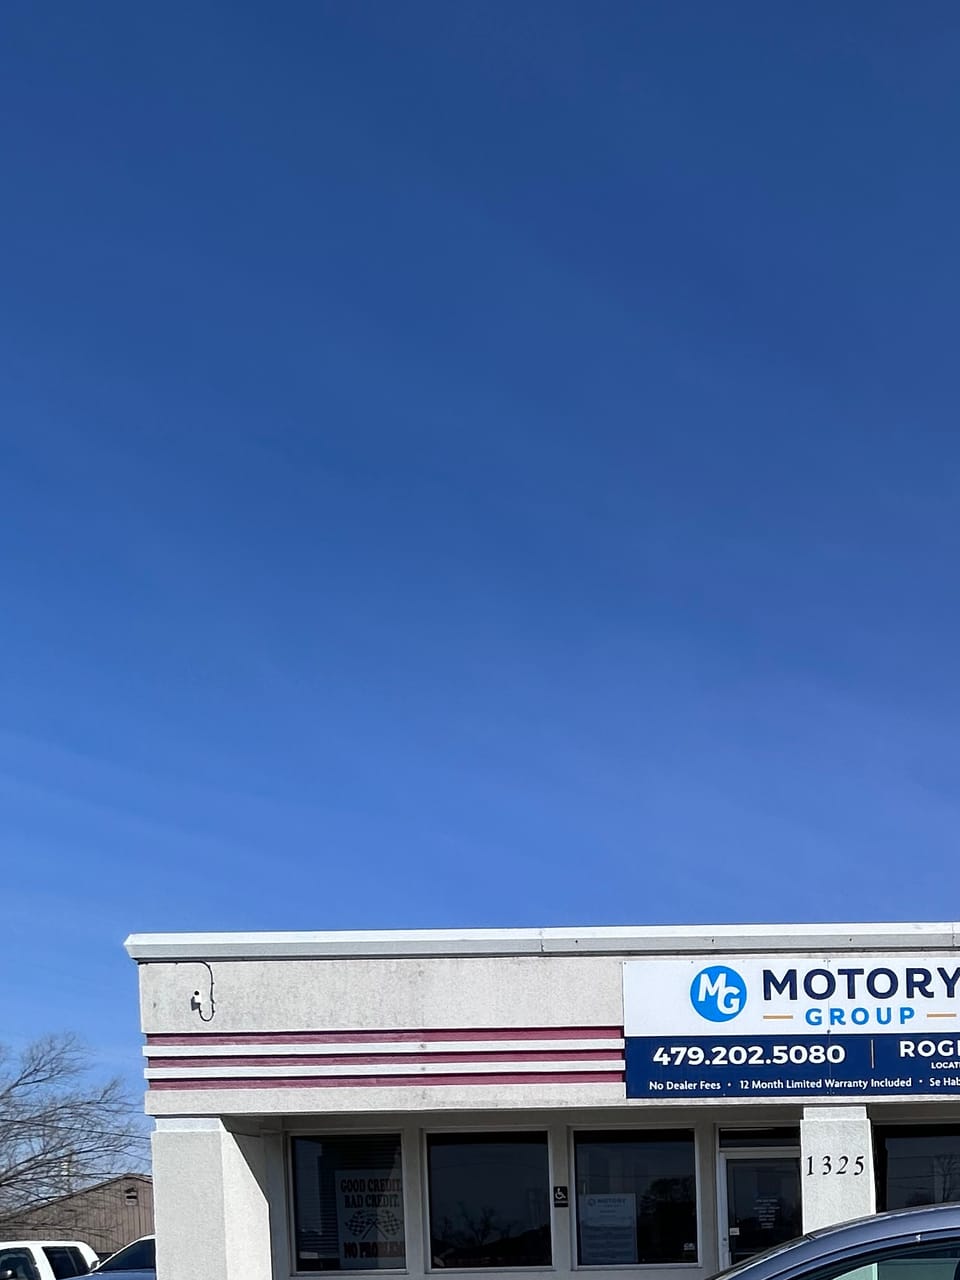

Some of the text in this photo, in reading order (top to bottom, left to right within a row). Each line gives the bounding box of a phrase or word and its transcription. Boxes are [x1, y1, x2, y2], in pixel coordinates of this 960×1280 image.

[697, 972, 741, 1015] MG
[804, 1006, 917, 1027] GROUP
[652, 1045, 846, 1066] 479.202.5080
[648, 1081, 665, 1091] No
[666, 1081, 698, 1091] Dealer
[699, 1081, 722, 1090] Fees
[739, 1080, 750, 1090] 12
[751, 1080, 784, 1090] Month
[786, 1079, 823, 1090] Limited
[824, 1078, 869, 1092] Warranty
[870, 1077, 913, 1089] Included
[929, 1077, 941, 1087] Se
[806, 1155, 865, 1177] 1325
[340, 1178, 366, 1193] GOOD
[344, 1194, 364, 1208] BAD
[343, 1241, 358, 1258] NO
